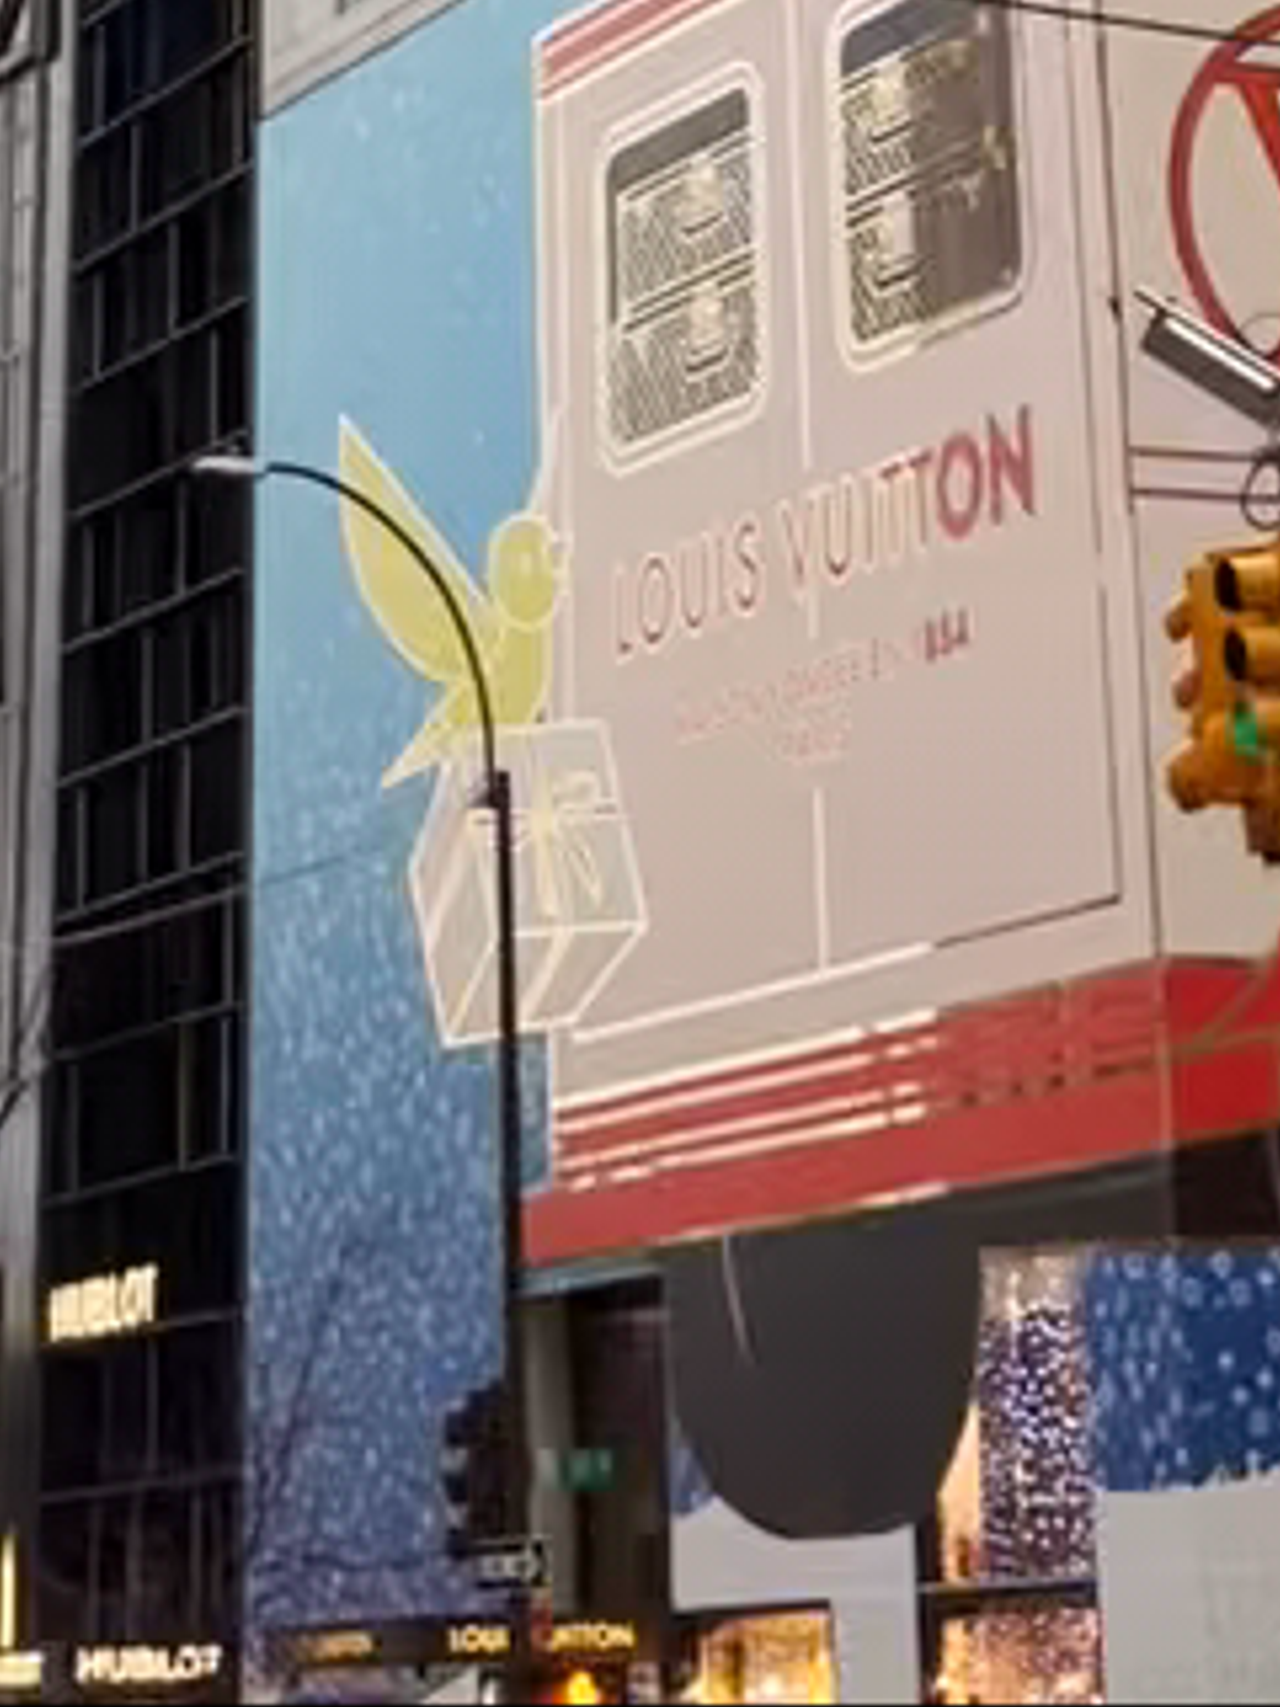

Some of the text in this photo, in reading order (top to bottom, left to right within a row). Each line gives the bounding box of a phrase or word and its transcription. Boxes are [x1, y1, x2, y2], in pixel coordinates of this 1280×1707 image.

[612, 402, 1037, 663] LOUIS VUITTON
[49, 1262, 160, 1343] HUBLOT
[74, 1642, 223, 1684] HUBLOT
